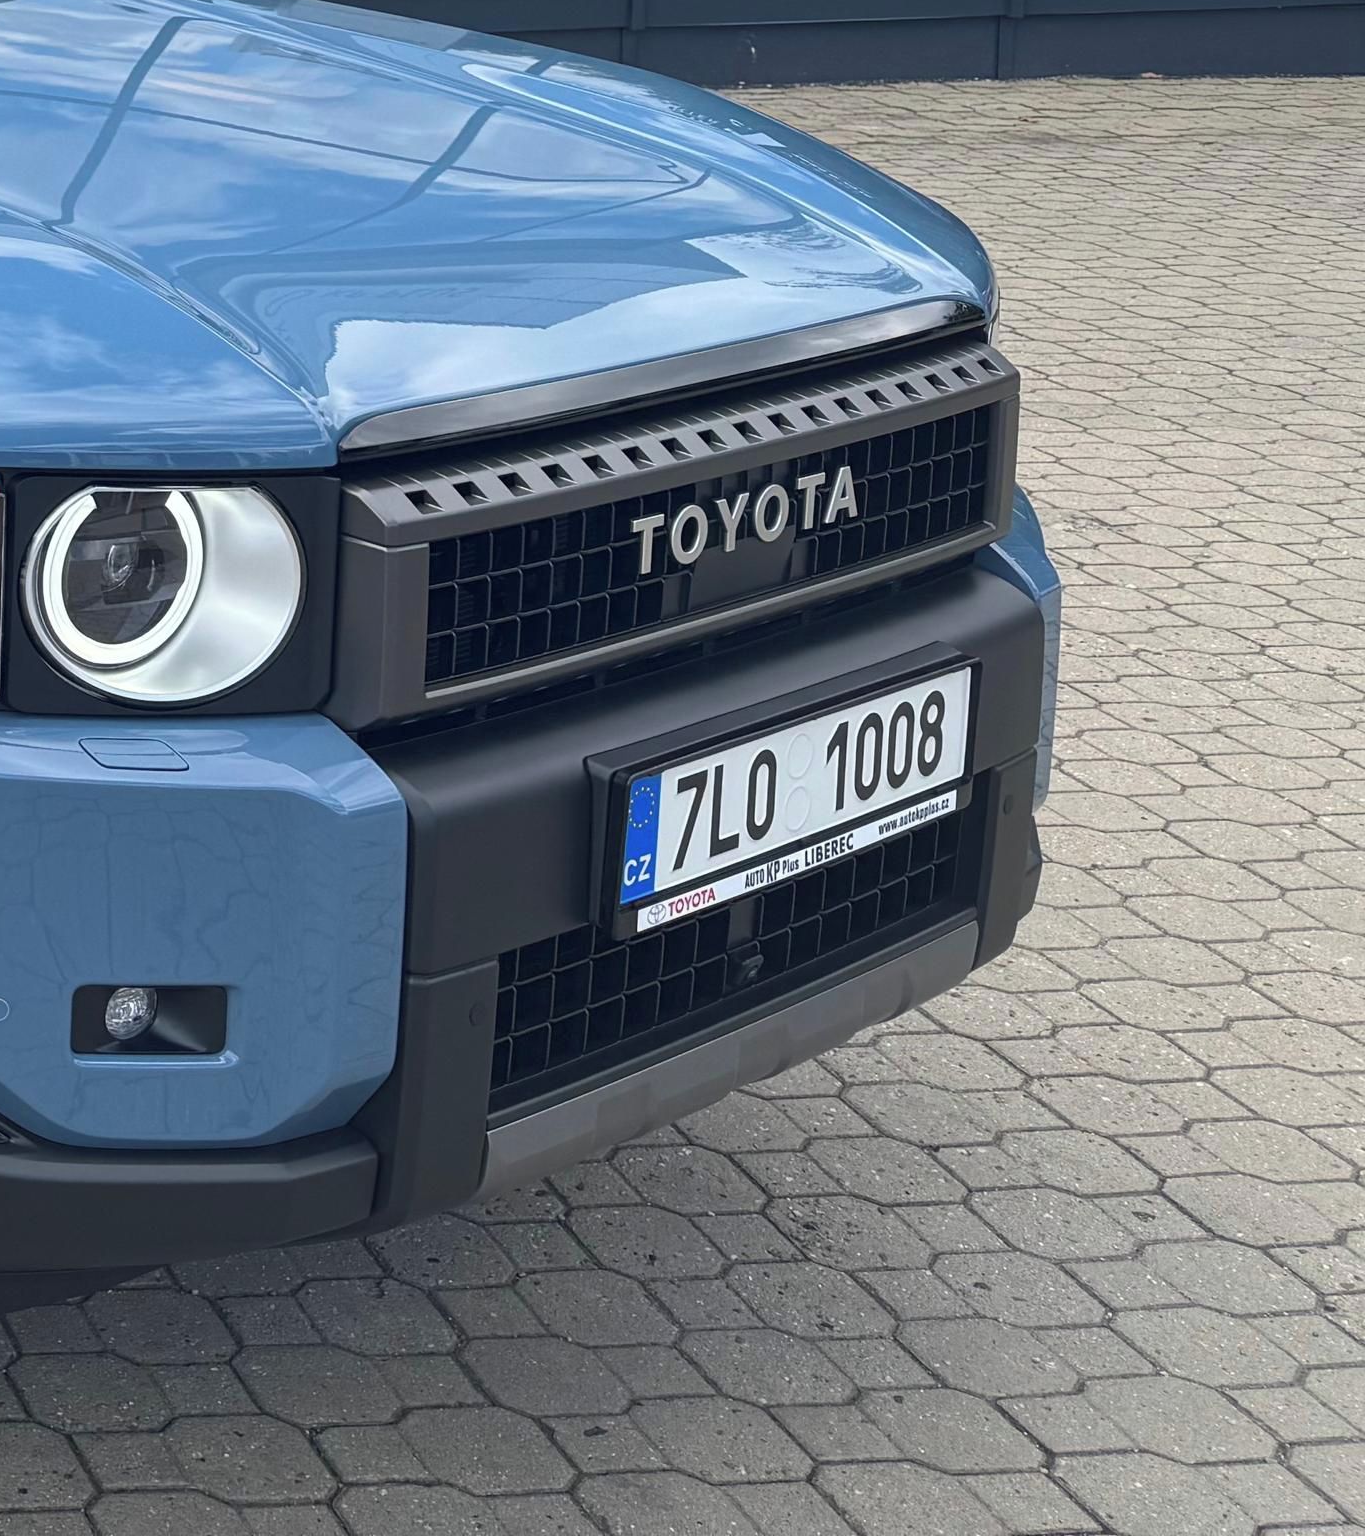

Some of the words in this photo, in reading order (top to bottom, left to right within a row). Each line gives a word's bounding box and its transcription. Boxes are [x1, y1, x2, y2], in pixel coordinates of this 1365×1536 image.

[630, 465, 859, 575] TOYOTA
[826, 690, 946, 812] 1008
[623, 854, 652, 887] CZ
[668, 887, 716, 915] TOYOTA
[744, 869, 765, 889] AUTO
[766, 861, 781, 884] KP
[782, 858, 800, 875] Plus
[804, 833, 854, 867] LIBEREC
